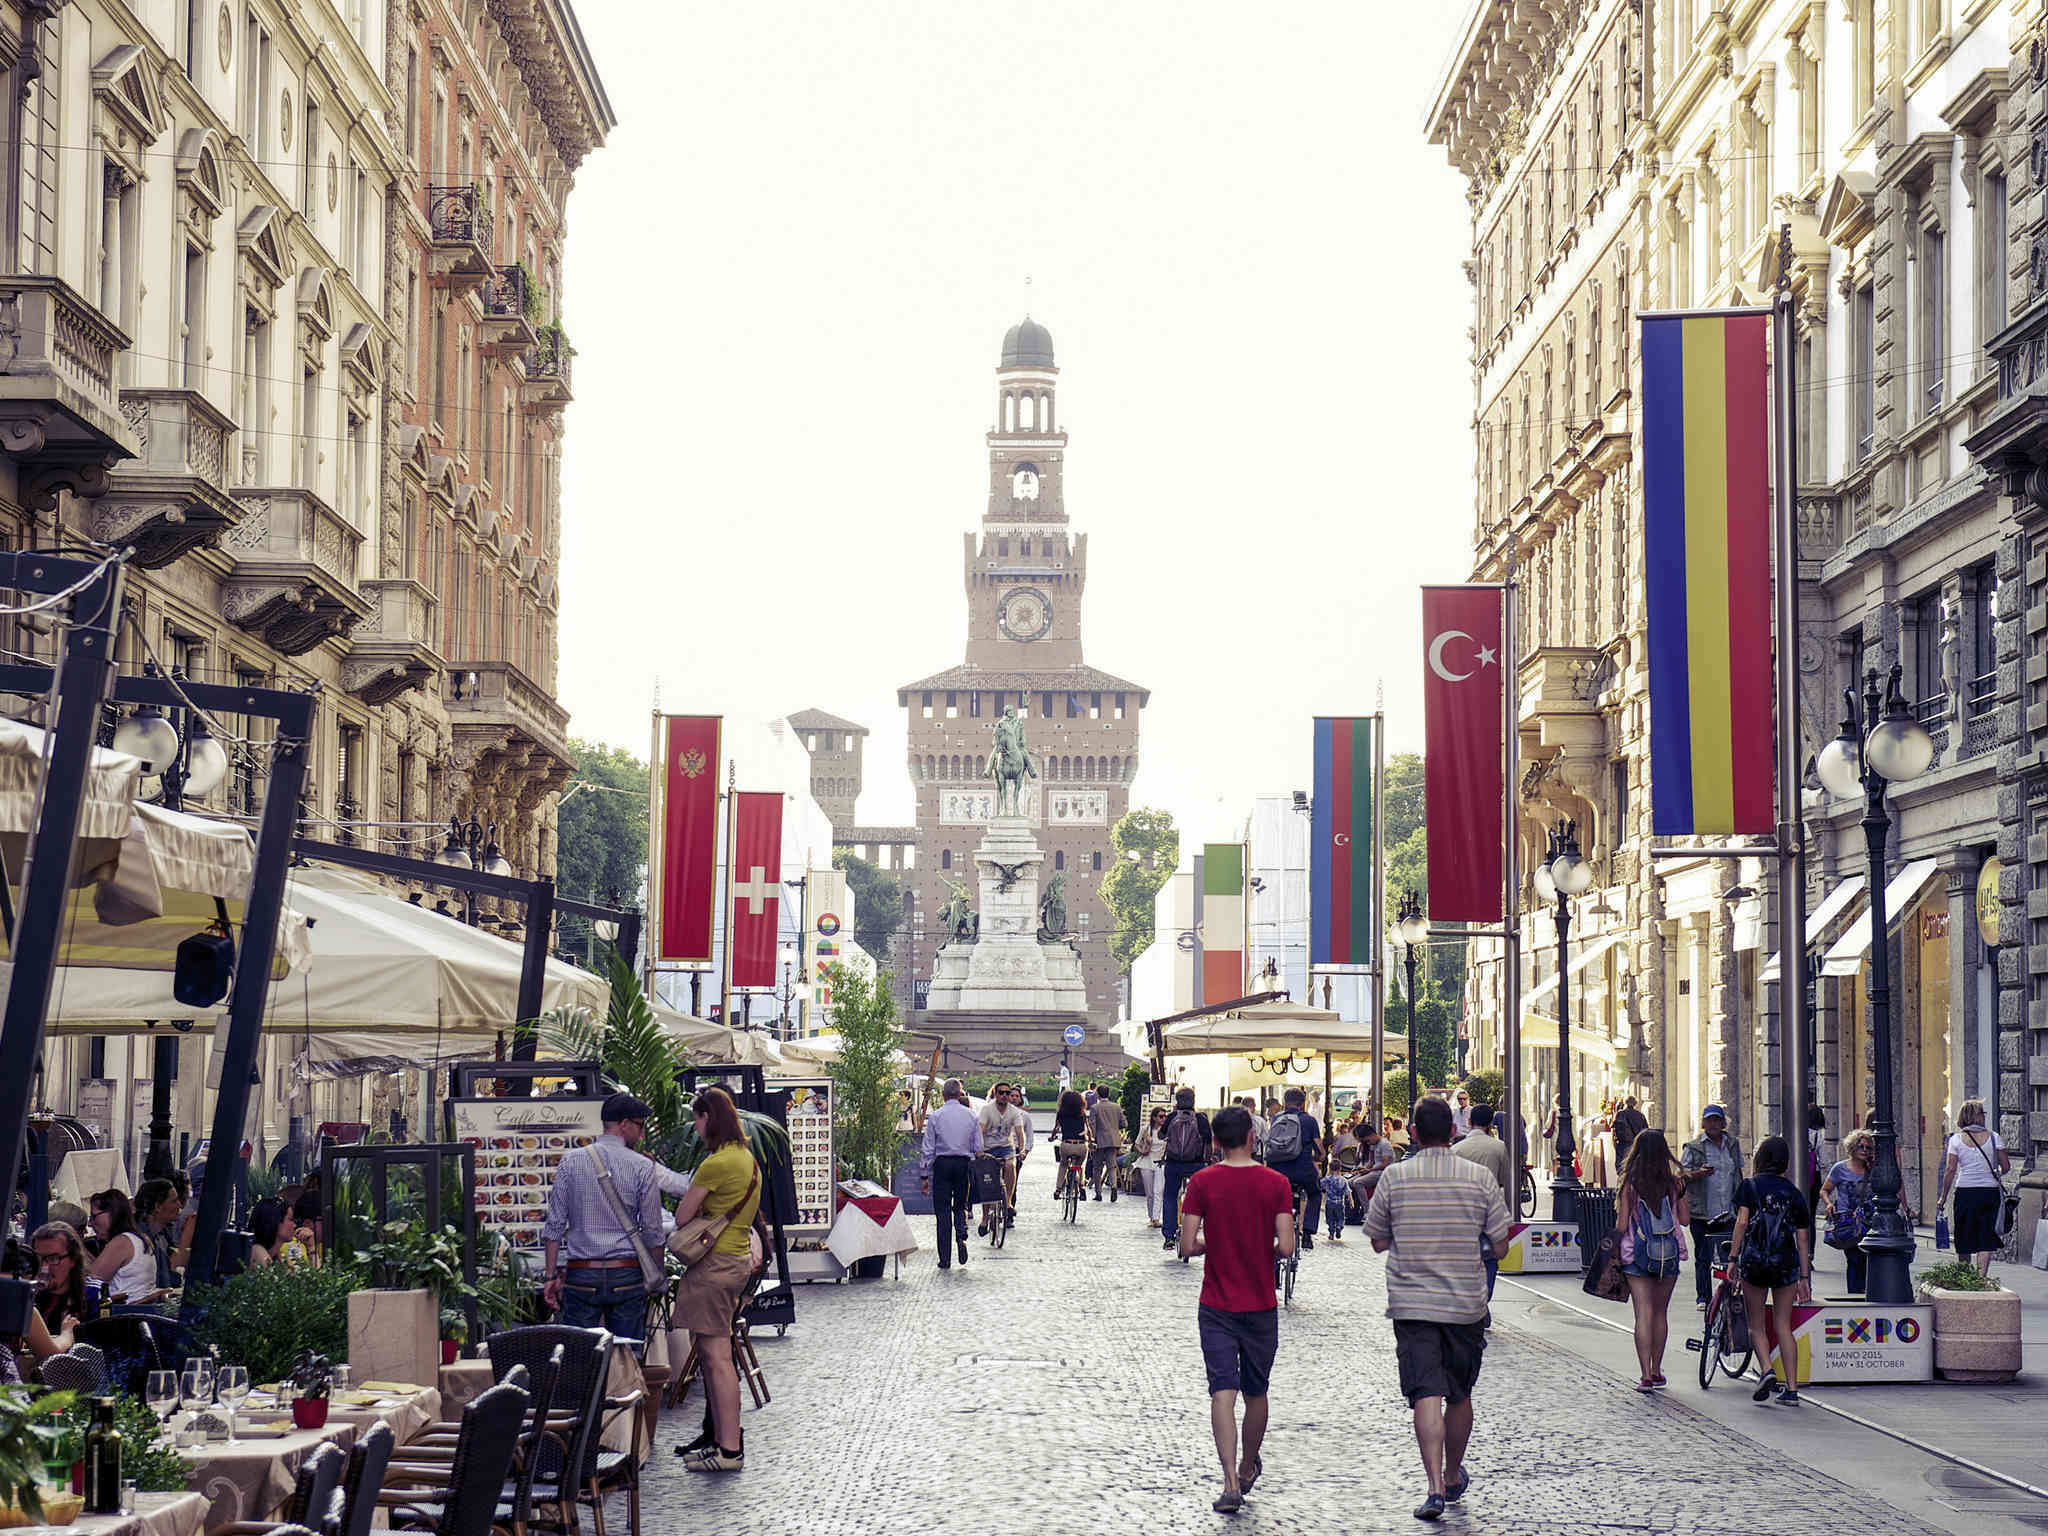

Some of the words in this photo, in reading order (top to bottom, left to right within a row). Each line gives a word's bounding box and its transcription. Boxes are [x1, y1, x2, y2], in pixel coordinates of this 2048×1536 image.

[537, 1105, 585, 1123] Dante
[1825, 1317, 1920, 1343] EXPO
[1825, 1352, 1860, 1360] MILANO
[1866, 1360, 1905, 1368] OCTOBER
